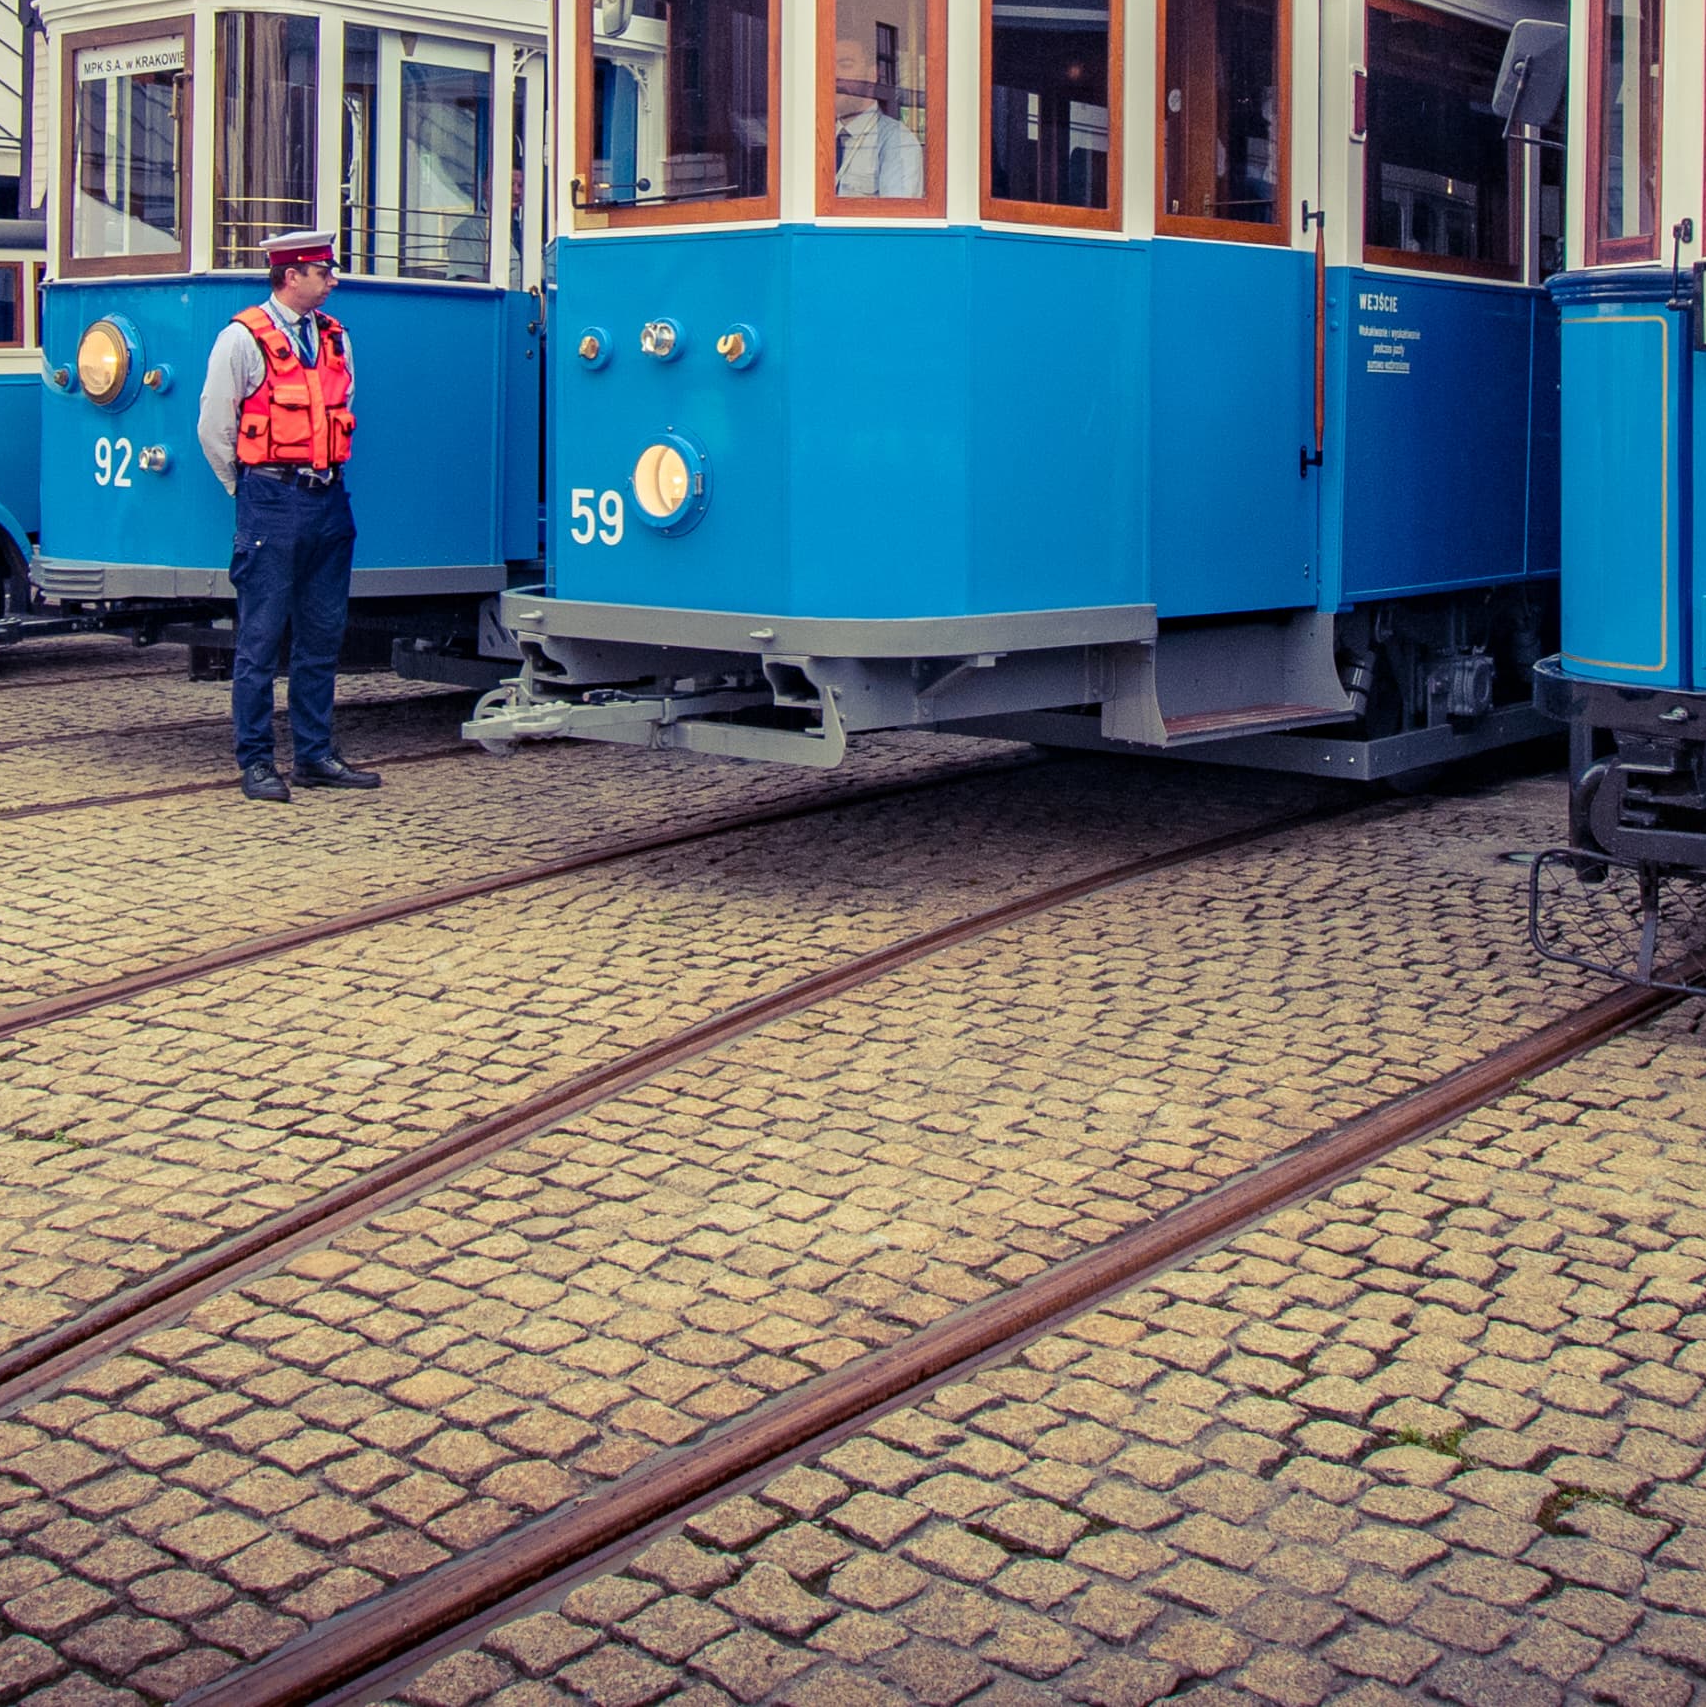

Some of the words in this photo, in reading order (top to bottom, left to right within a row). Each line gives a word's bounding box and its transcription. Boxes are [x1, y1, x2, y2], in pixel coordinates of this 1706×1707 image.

[84, 62, 103, 74] MPK
[106, 59, 123, 71] S.A.
[125, 61, 133, 70] w
[135, 51, 185, 68] KRAKOWIE
[1359, 292, 1398, 313] WEJŚCIE
[94, 436, 133, 487] 92
[570, 488, 624, 546] 59
